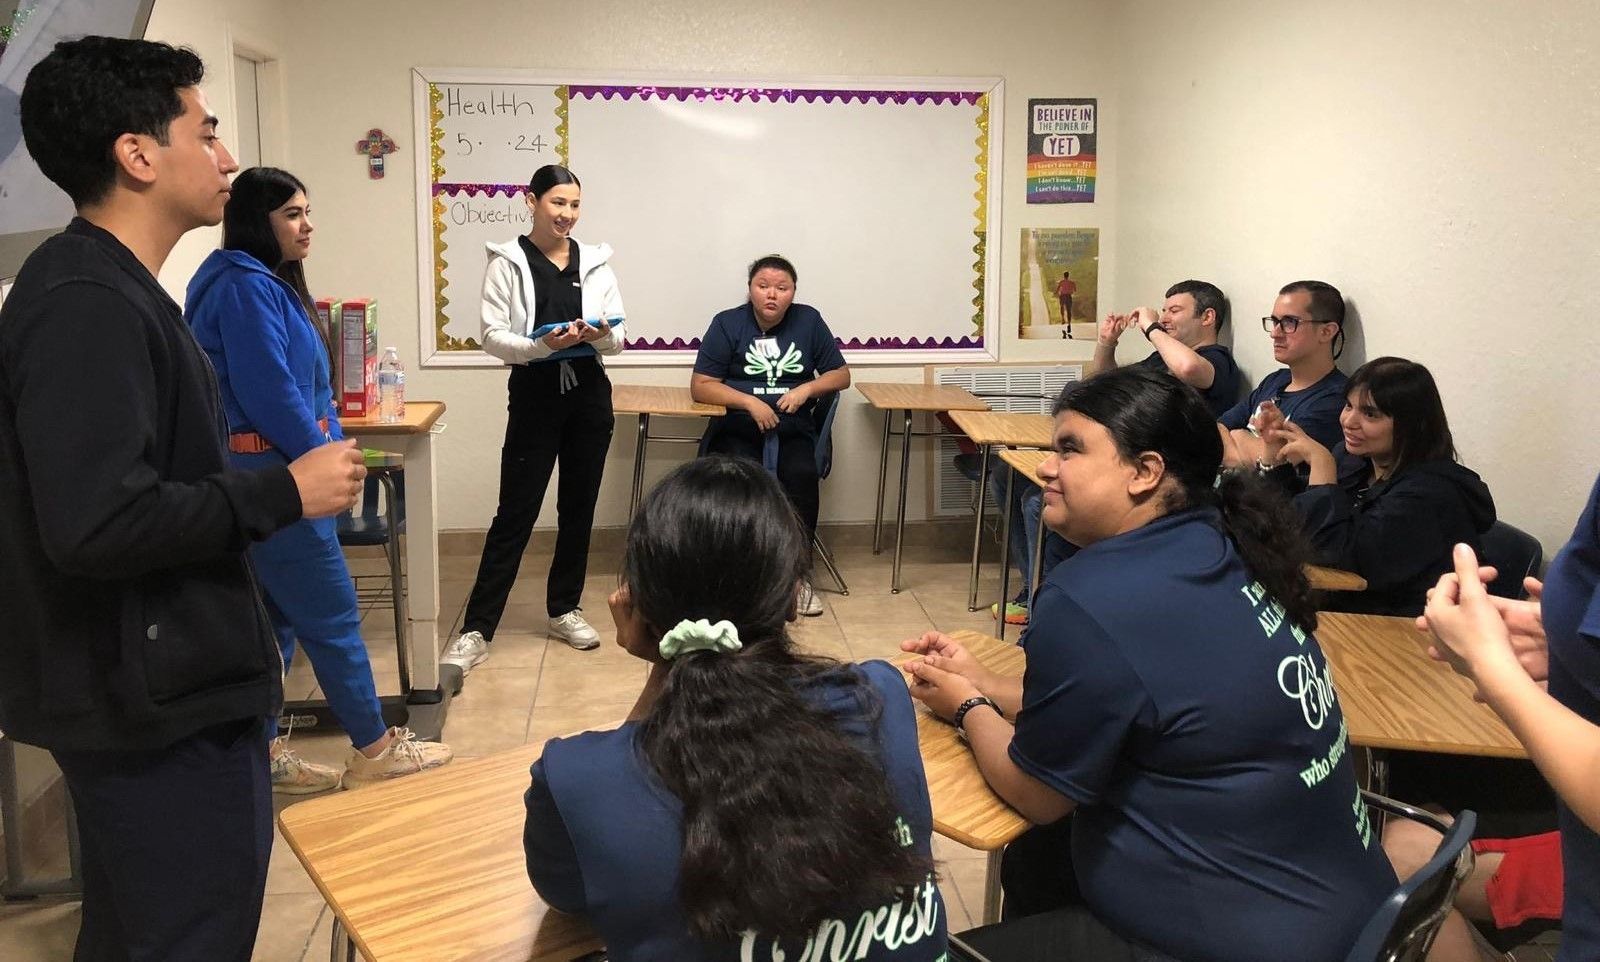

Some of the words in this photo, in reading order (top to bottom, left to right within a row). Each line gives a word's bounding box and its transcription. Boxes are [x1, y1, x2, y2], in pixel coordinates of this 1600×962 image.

[447, 87, 534, 116] Health
[1037, 108, 1077, 121] BELIEVE
[1080, 108, 1092, 121] IN
[1039, 121, 1052, 131] THE
[1055, 121, 1079, 131] POWER
[1081, 121, 1089, 131] OF
[1049, 138, 1074, 155] YET
[1240, 585, 1259, 607] I
[1257, 606, 1283, 639] ALL
[1299, 758, 1330, 788] who
